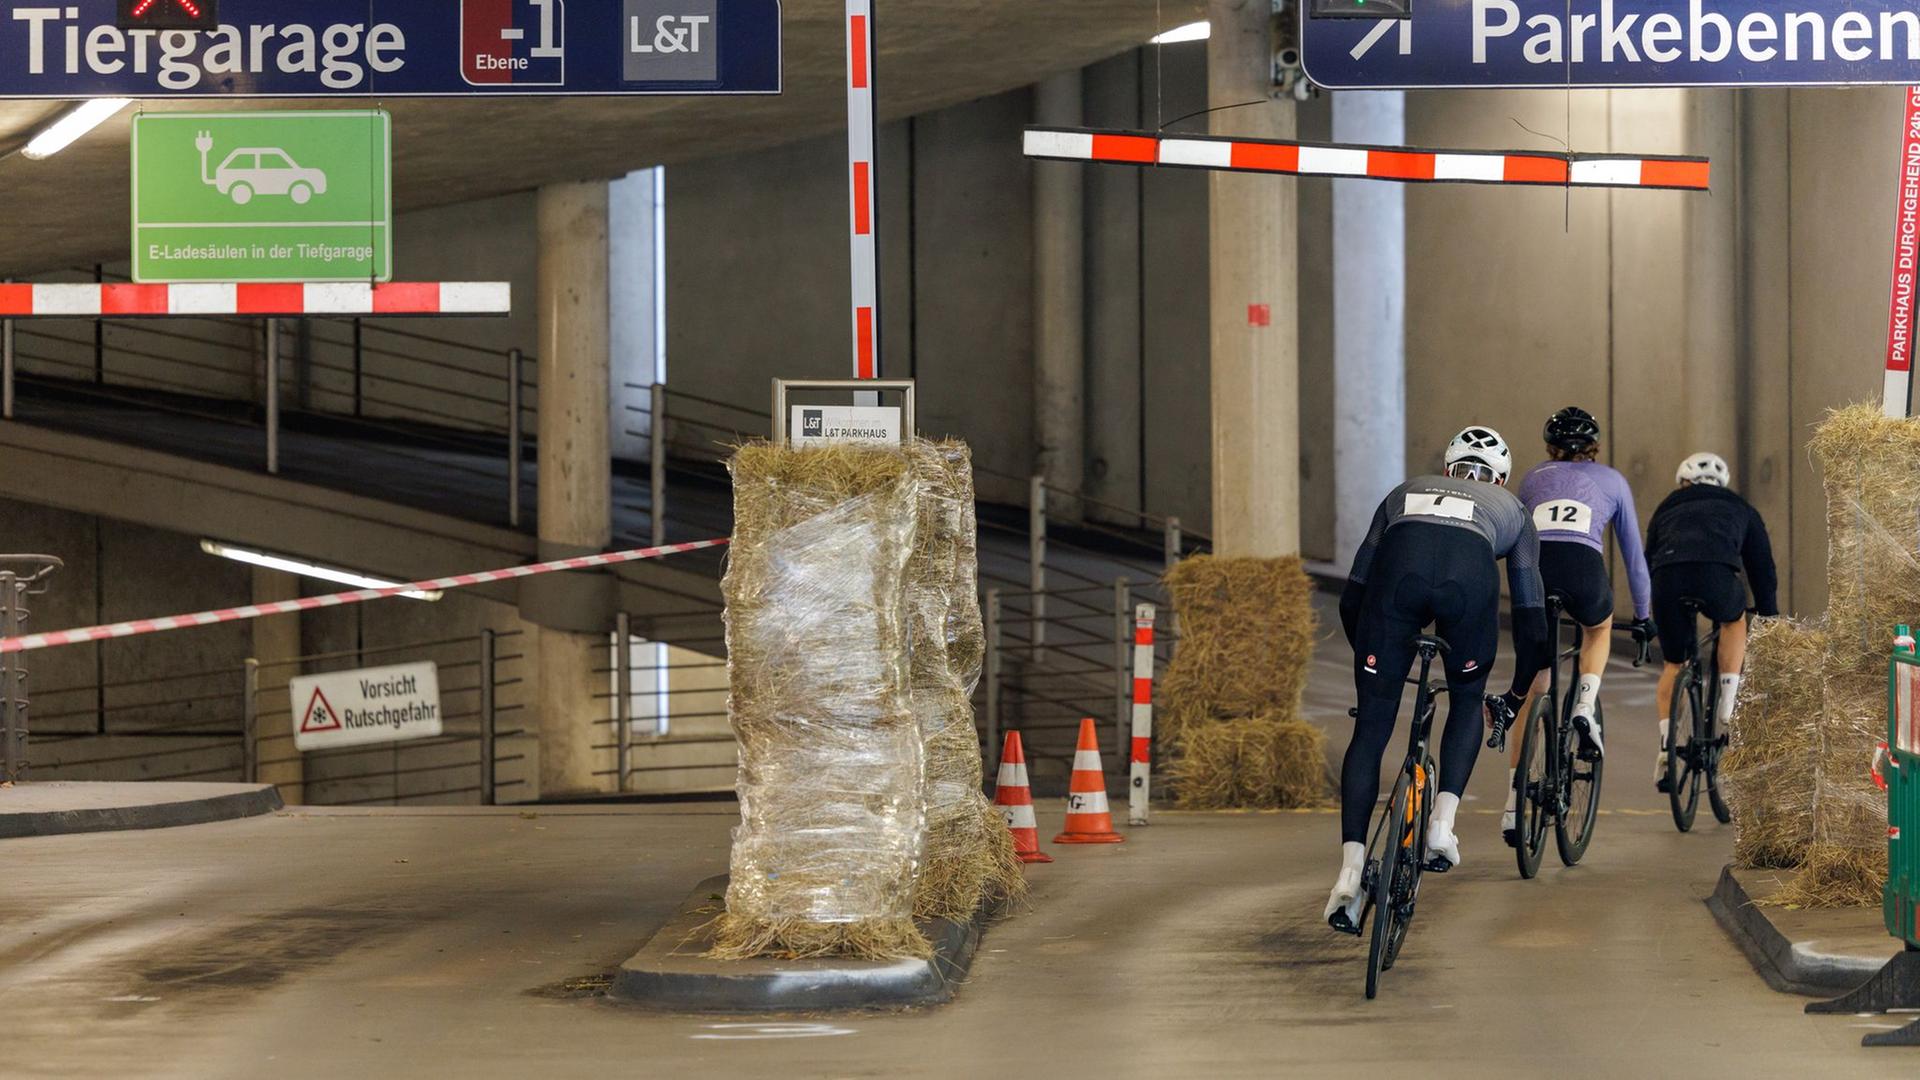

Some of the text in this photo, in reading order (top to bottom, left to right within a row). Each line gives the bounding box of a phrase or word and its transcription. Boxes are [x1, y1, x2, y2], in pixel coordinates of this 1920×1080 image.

[630, 15, 709, 53] L&T
[1472, 0, 1920, 64] Parkebenen
[12, 7, 406, 90] Tiefgarage
[476, 54, 528, 70] Ebene
[1899, 142, 1920, 269] DURCHGEHEND
[149, 243, 373, 261] E-Ladesäulen in der Tiefgarage
[1892, 272, 1911, 361] PARKHAUS
[804, 417, 821, 429] L&T
[825, 428, 887, 438] L&T PARKHAUS
[1548, 506, 1578, 522] 12
[360, 674, 417, 699] Vorsicht
[345, 701, 436, 729] Rutschgefahr
